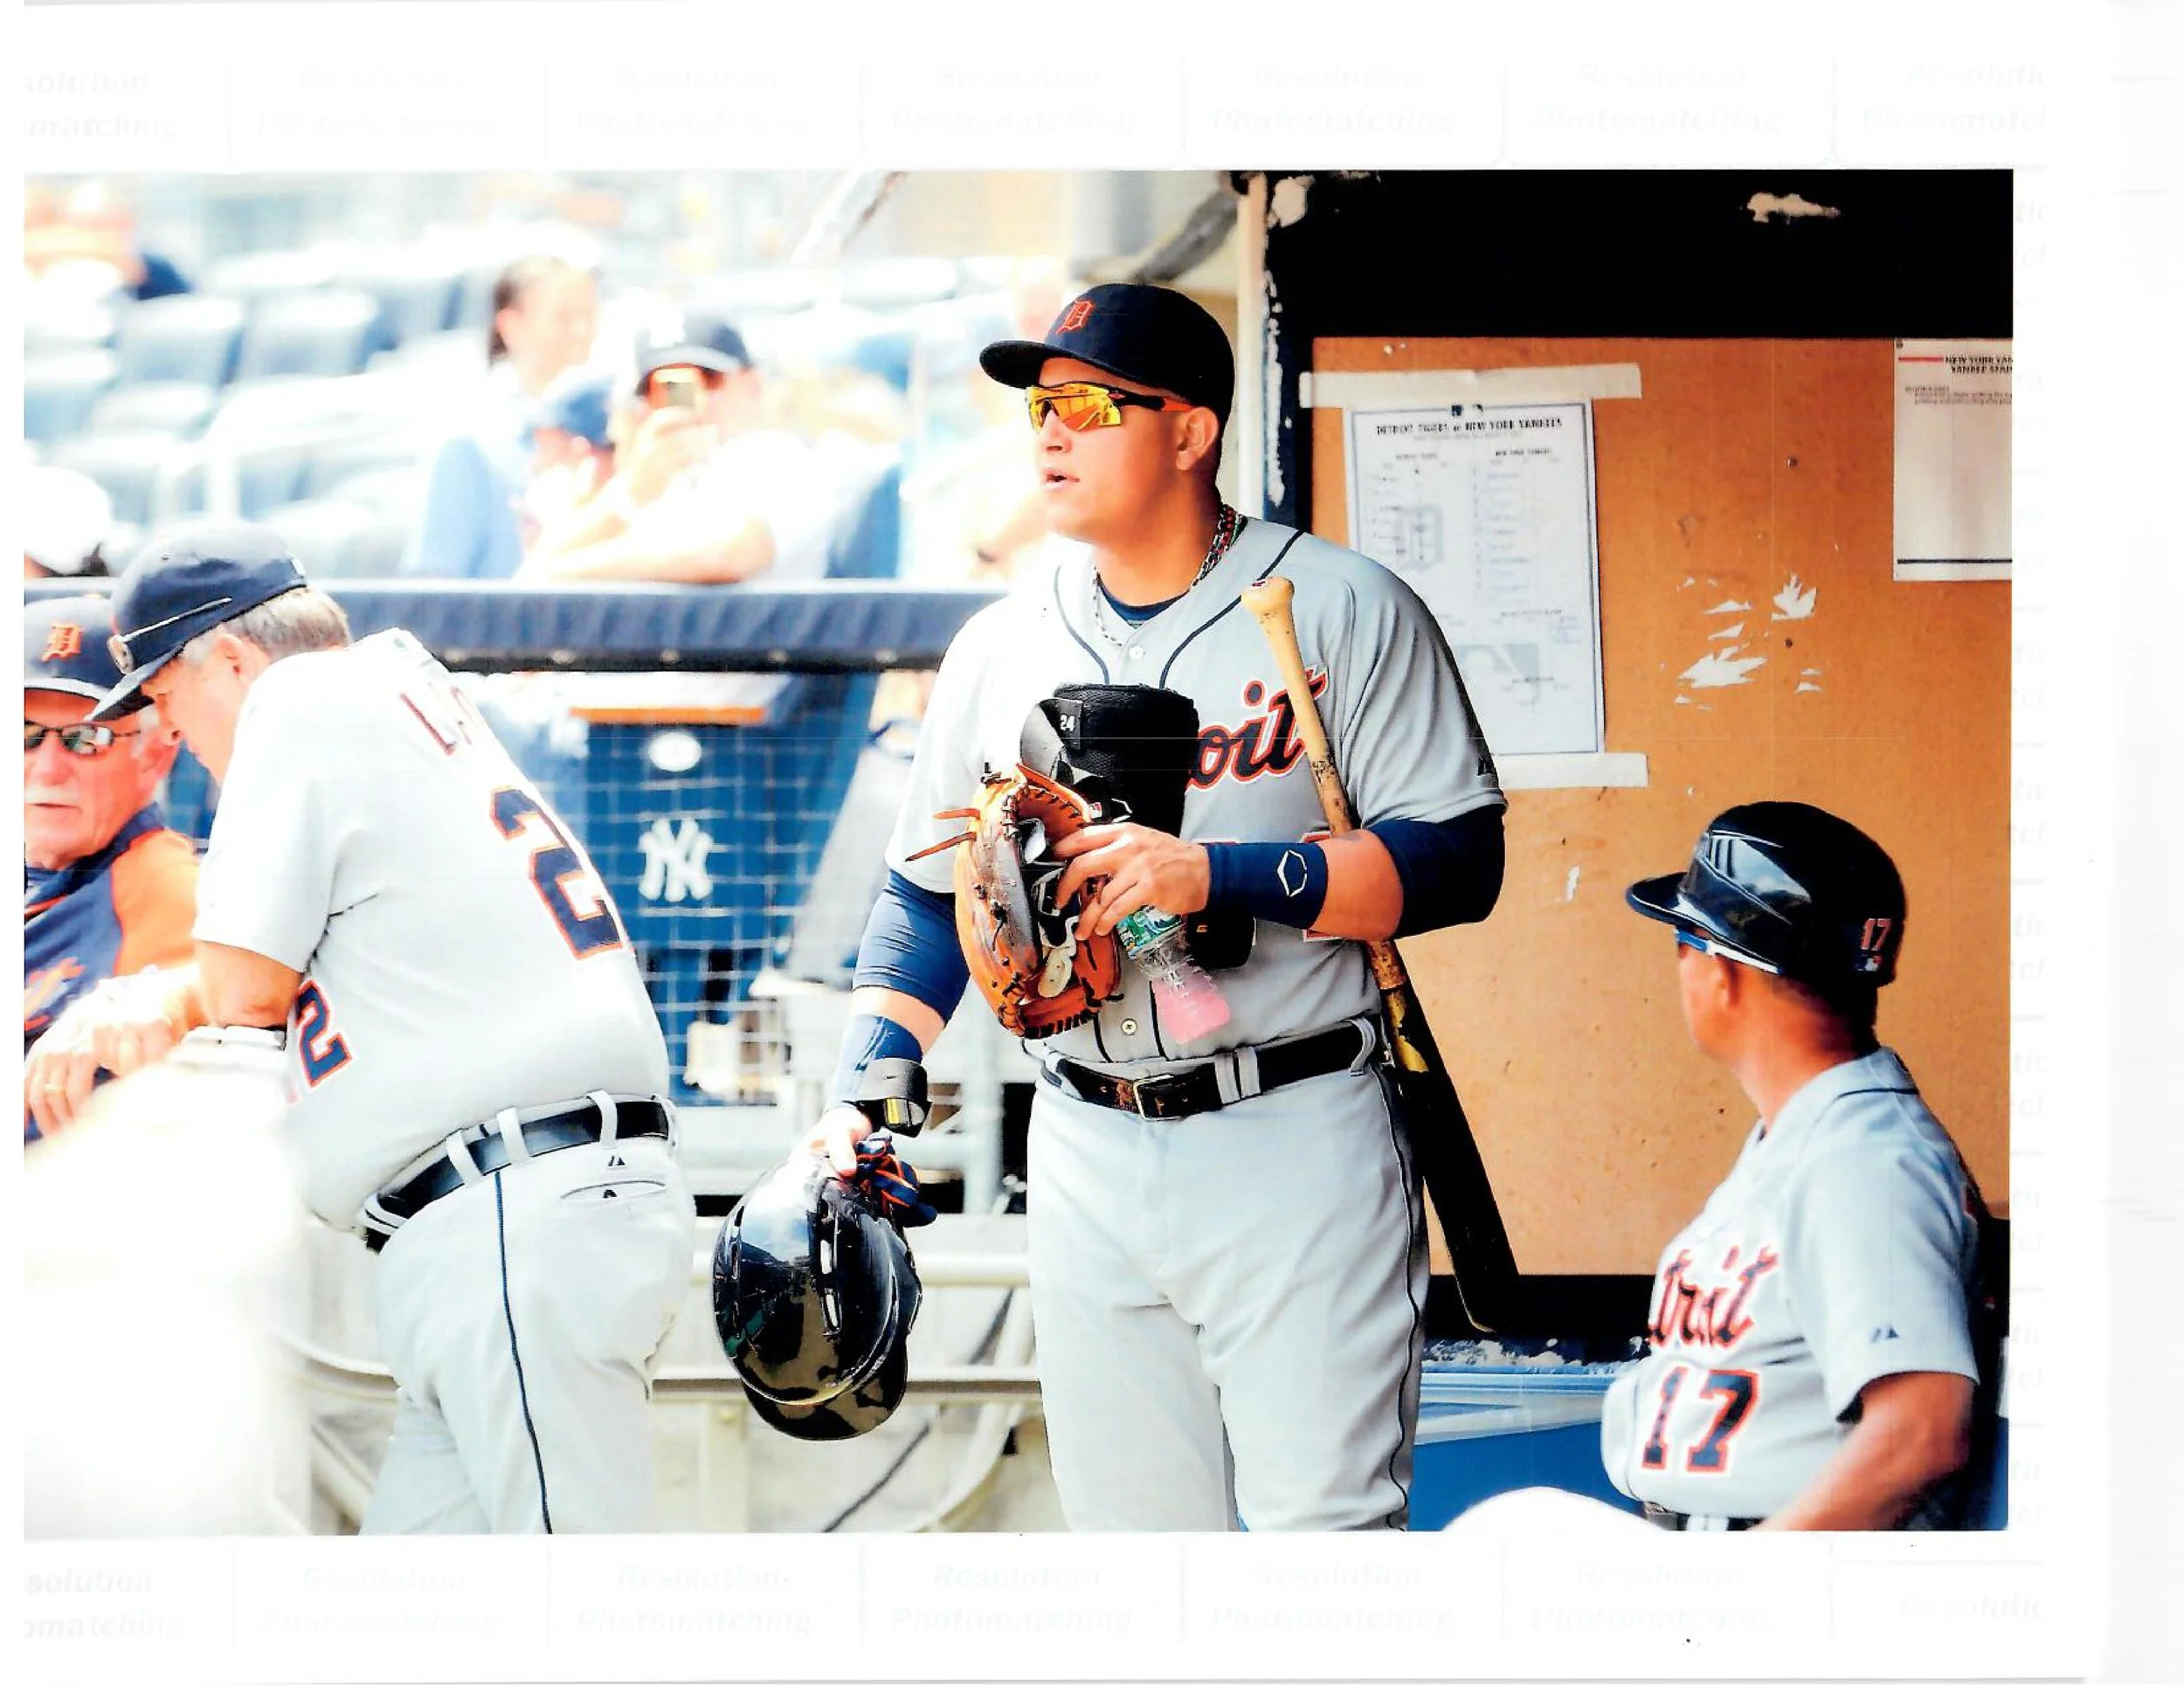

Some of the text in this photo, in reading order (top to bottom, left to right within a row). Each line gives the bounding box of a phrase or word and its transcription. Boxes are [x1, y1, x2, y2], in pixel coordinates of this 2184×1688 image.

[1056, 300, 1095, 335] D
[42, 623, 83, 661] D
[1060, 714, 1076, 731] 24
[1859, 917, 1892, 951] 17
[1641, 1365, 1761, 1473] 17
